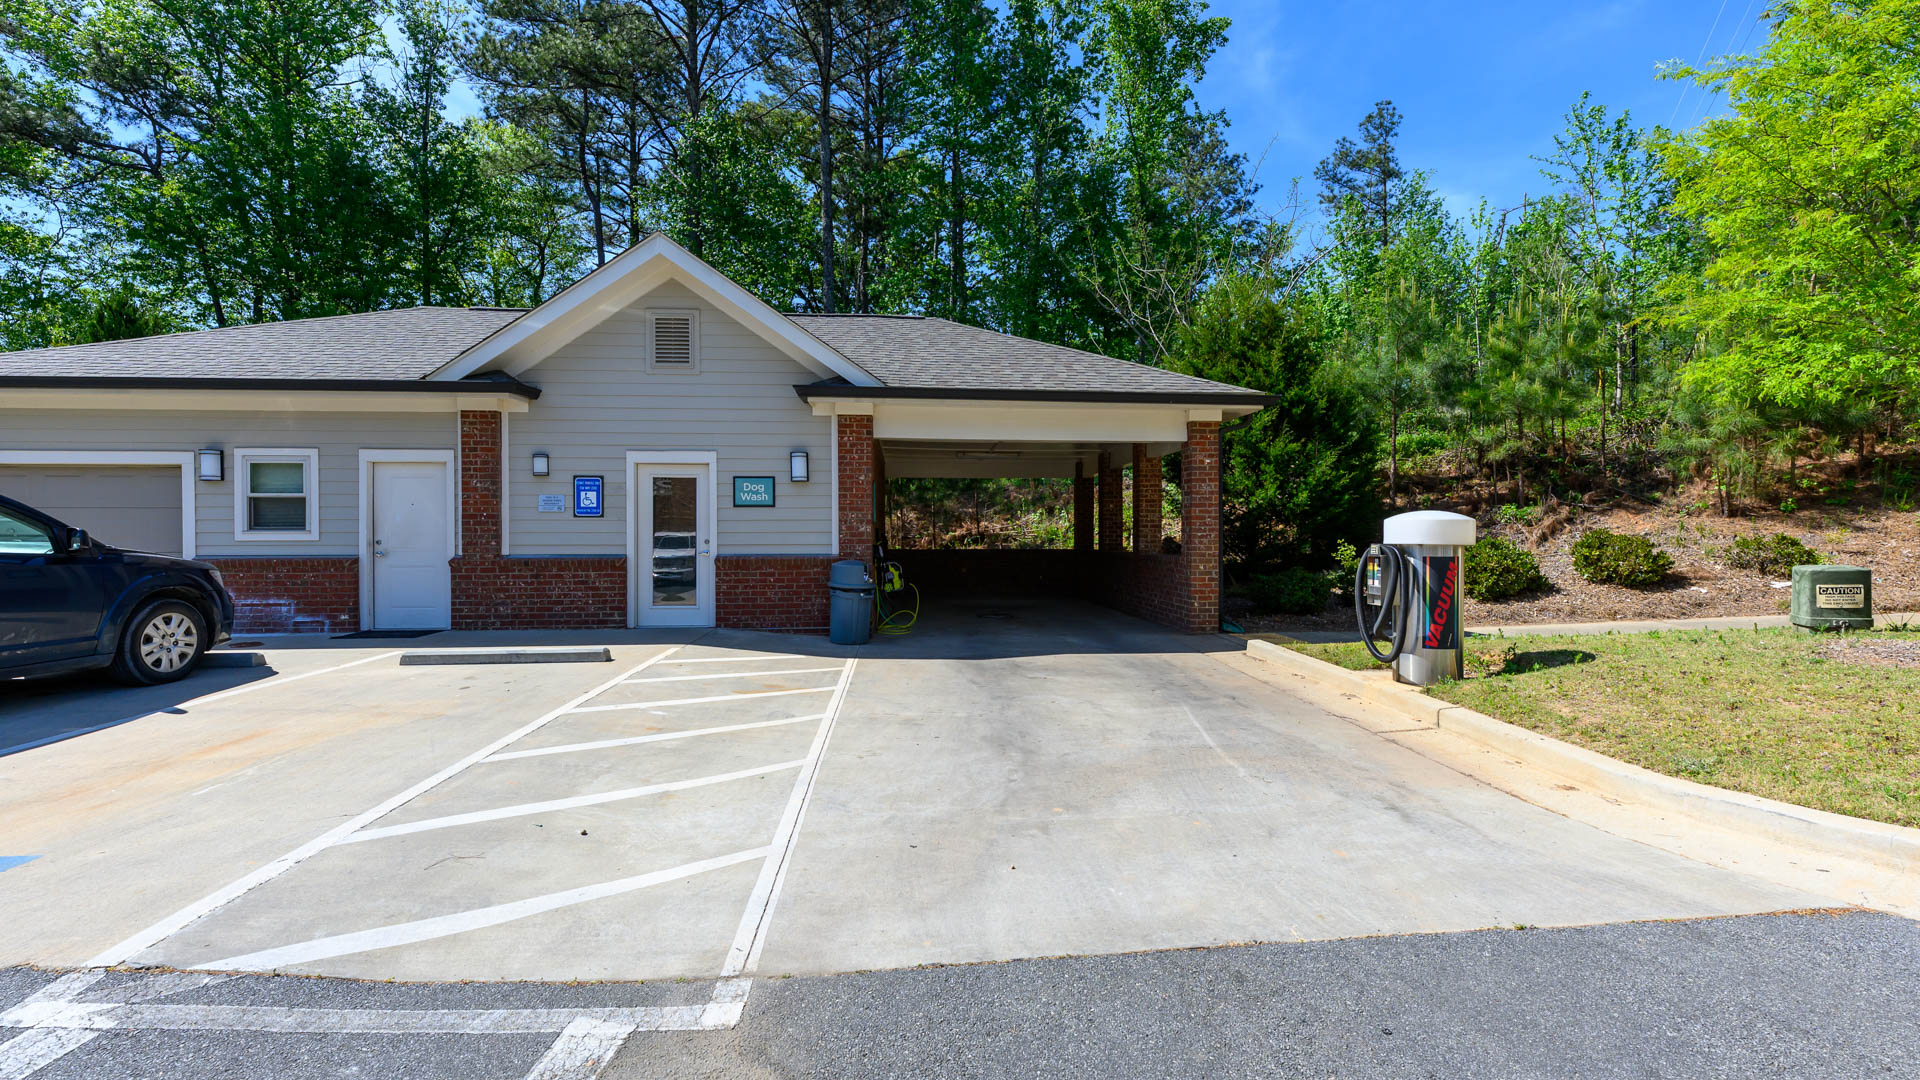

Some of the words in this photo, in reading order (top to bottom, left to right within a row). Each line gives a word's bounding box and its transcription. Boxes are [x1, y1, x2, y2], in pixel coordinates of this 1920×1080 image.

[744, 482, 765, 492] Dog
[740, 492, 768, 501] Wash
[1425, 561, 1458, 648] VACUUM
